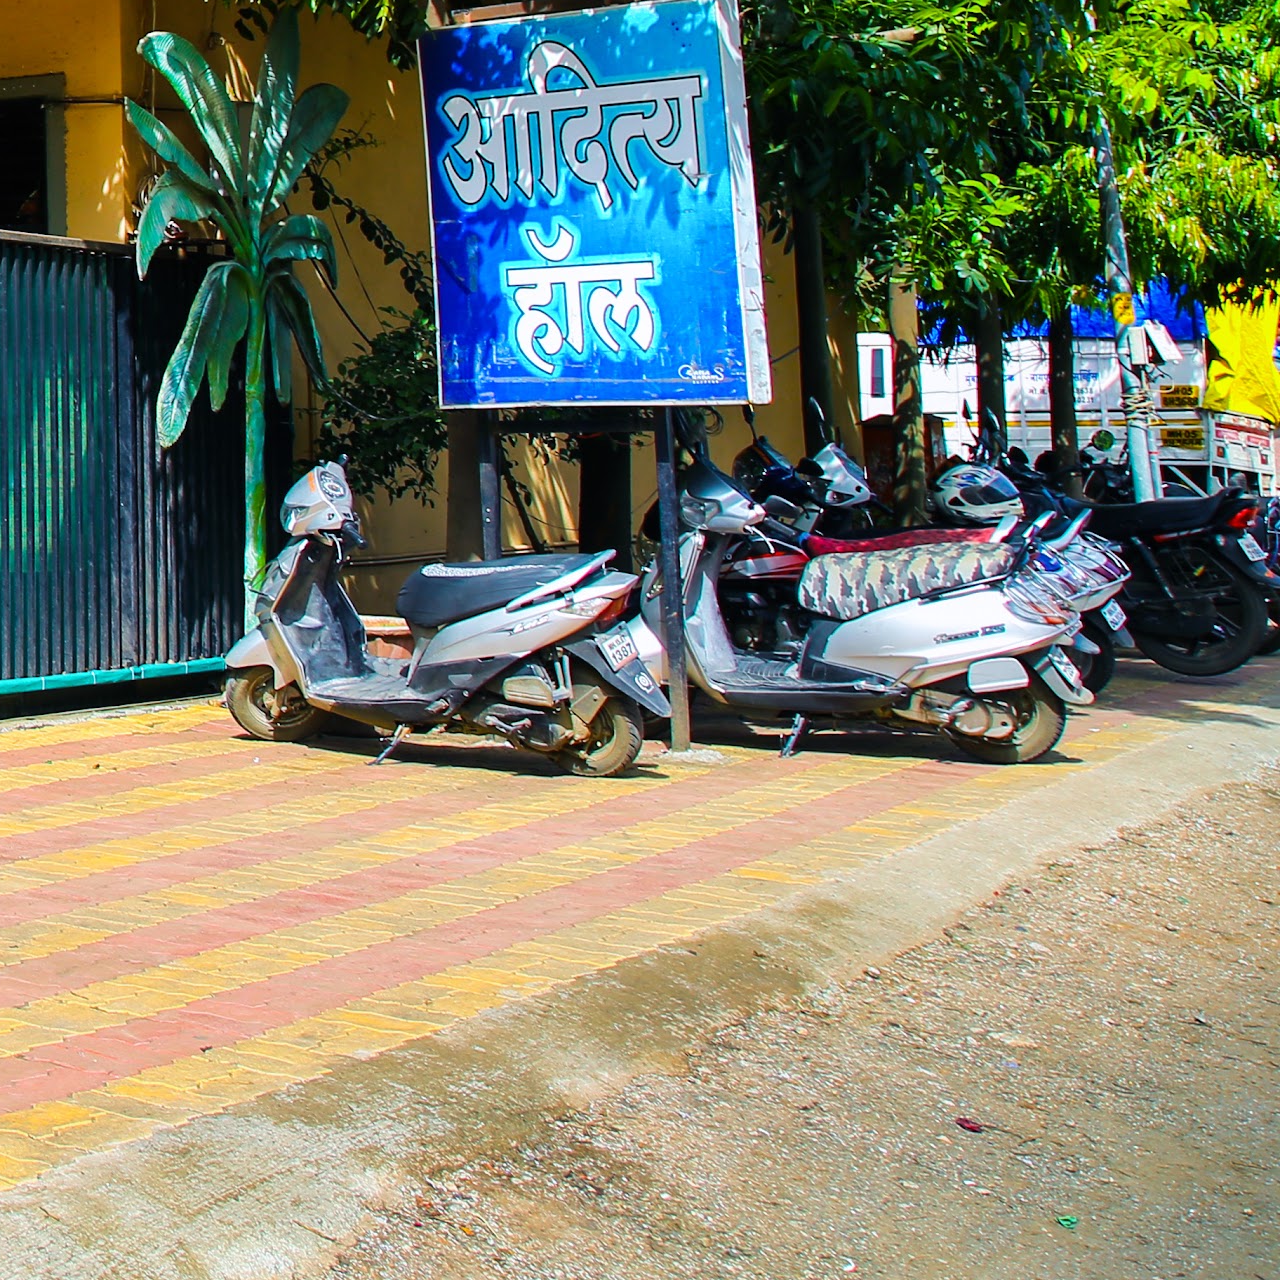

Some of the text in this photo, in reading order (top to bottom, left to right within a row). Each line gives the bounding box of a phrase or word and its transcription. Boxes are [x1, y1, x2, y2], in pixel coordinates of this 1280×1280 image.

[443, 40, 703, 210] आदित्य
[506, 224, 656, 374] हॉल
[612, 642, 633, 663] 1387
